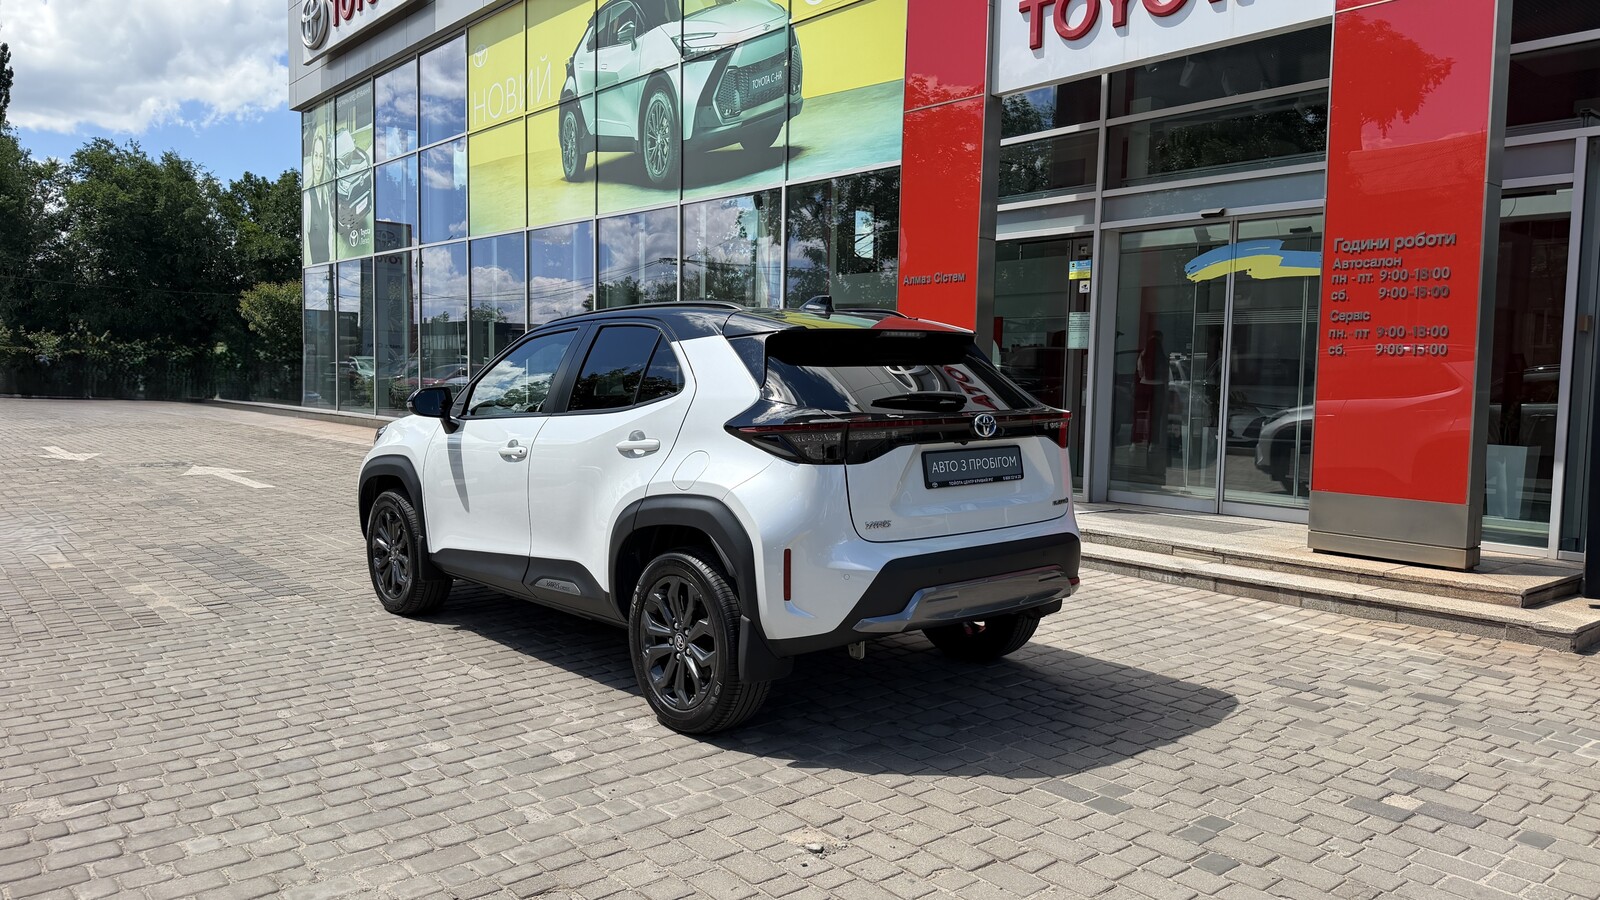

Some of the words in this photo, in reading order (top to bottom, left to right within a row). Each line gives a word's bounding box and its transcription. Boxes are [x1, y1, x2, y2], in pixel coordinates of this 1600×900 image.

[771, 70, 782, 83] C-HR
[473, 54, 551, 126] НОВИЙ
[1333, 237, 1390, 253] Години
[1394, 231, 1456, 253] роботи
[1332, 257, 1402, 270] Автосалон
[903, 275, 931, 286] Алмаз
[934, 272, 966, 284] Сістем
[1331, 289, 1349, 301] сб.
[1330, 309, 1371, 324] Сервіс
[1328, 343, 1346, 356] сб.
[932, 460, 958, 473] АВТО
[969, 456, 1017, 470] ПРОБІГОМ
